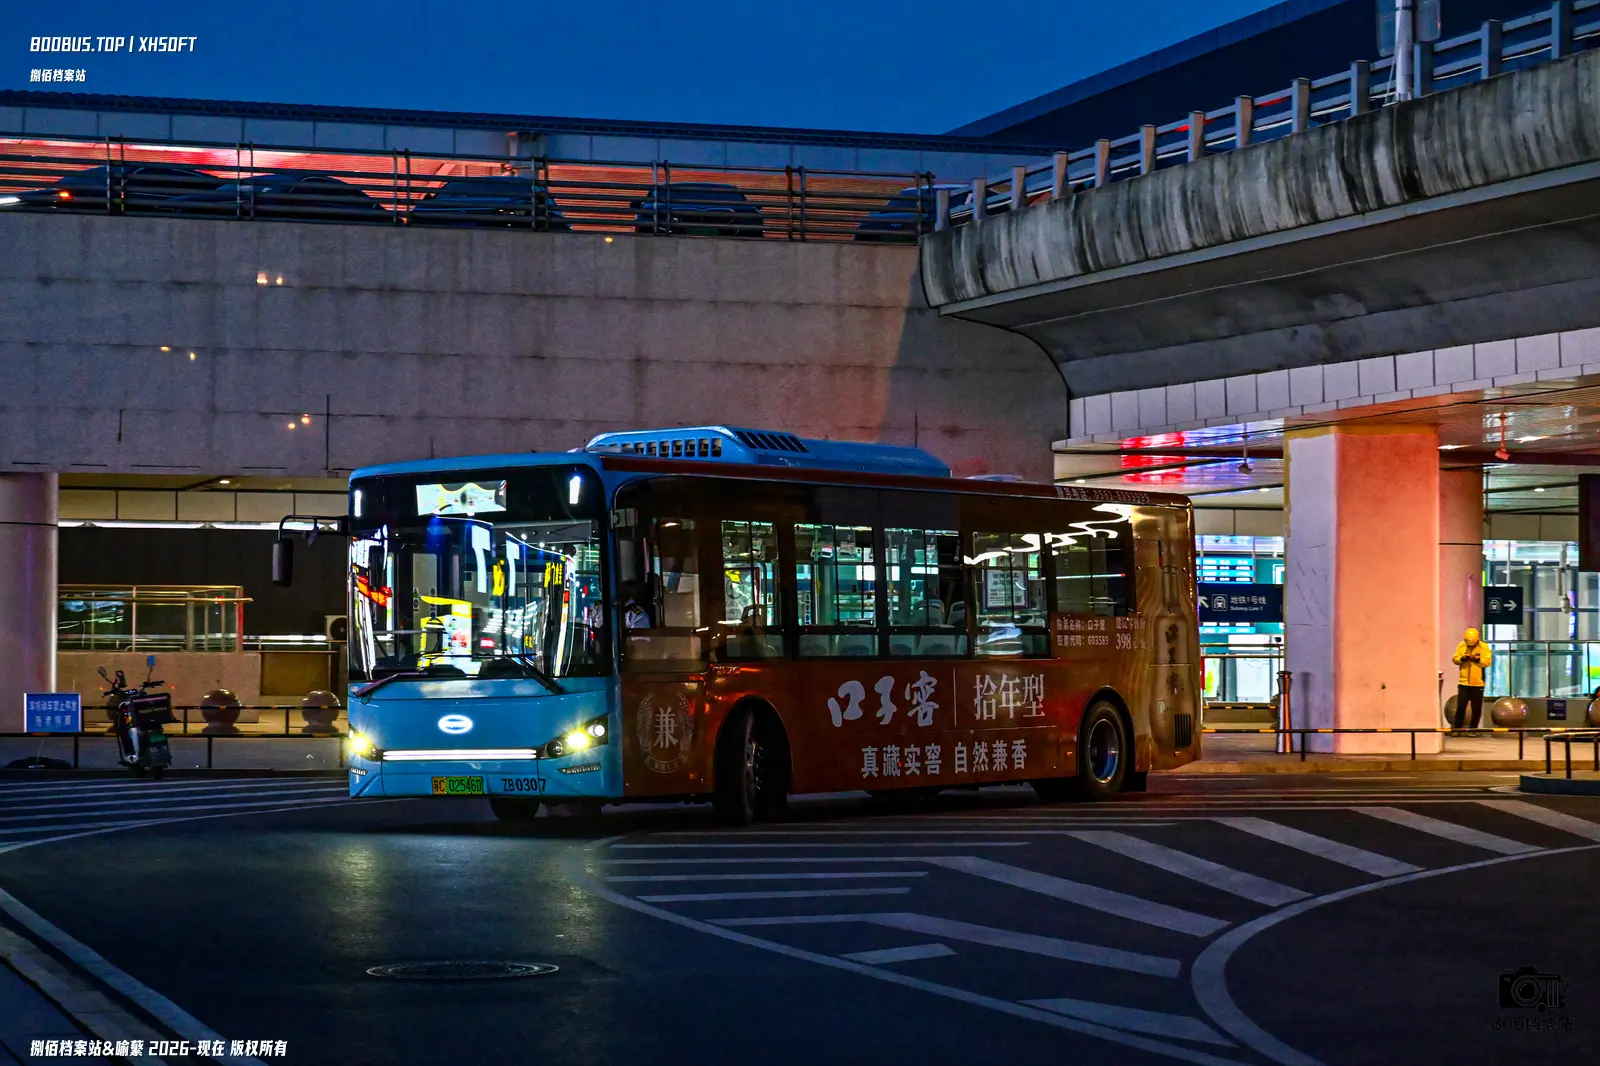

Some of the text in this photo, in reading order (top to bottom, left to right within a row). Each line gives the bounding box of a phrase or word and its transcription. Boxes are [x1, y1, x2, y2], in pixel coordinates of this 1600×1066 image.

[1230, 595, 1267, 605] 地铁1号线
[828, 670, 1046, 727] 口子窖 拾年型
[652, 704, 679, 749] 兼
[861, 738, 1028, 778] 真藏实窖 自然兼香
[501, 777, 547, 792] ZB0307
